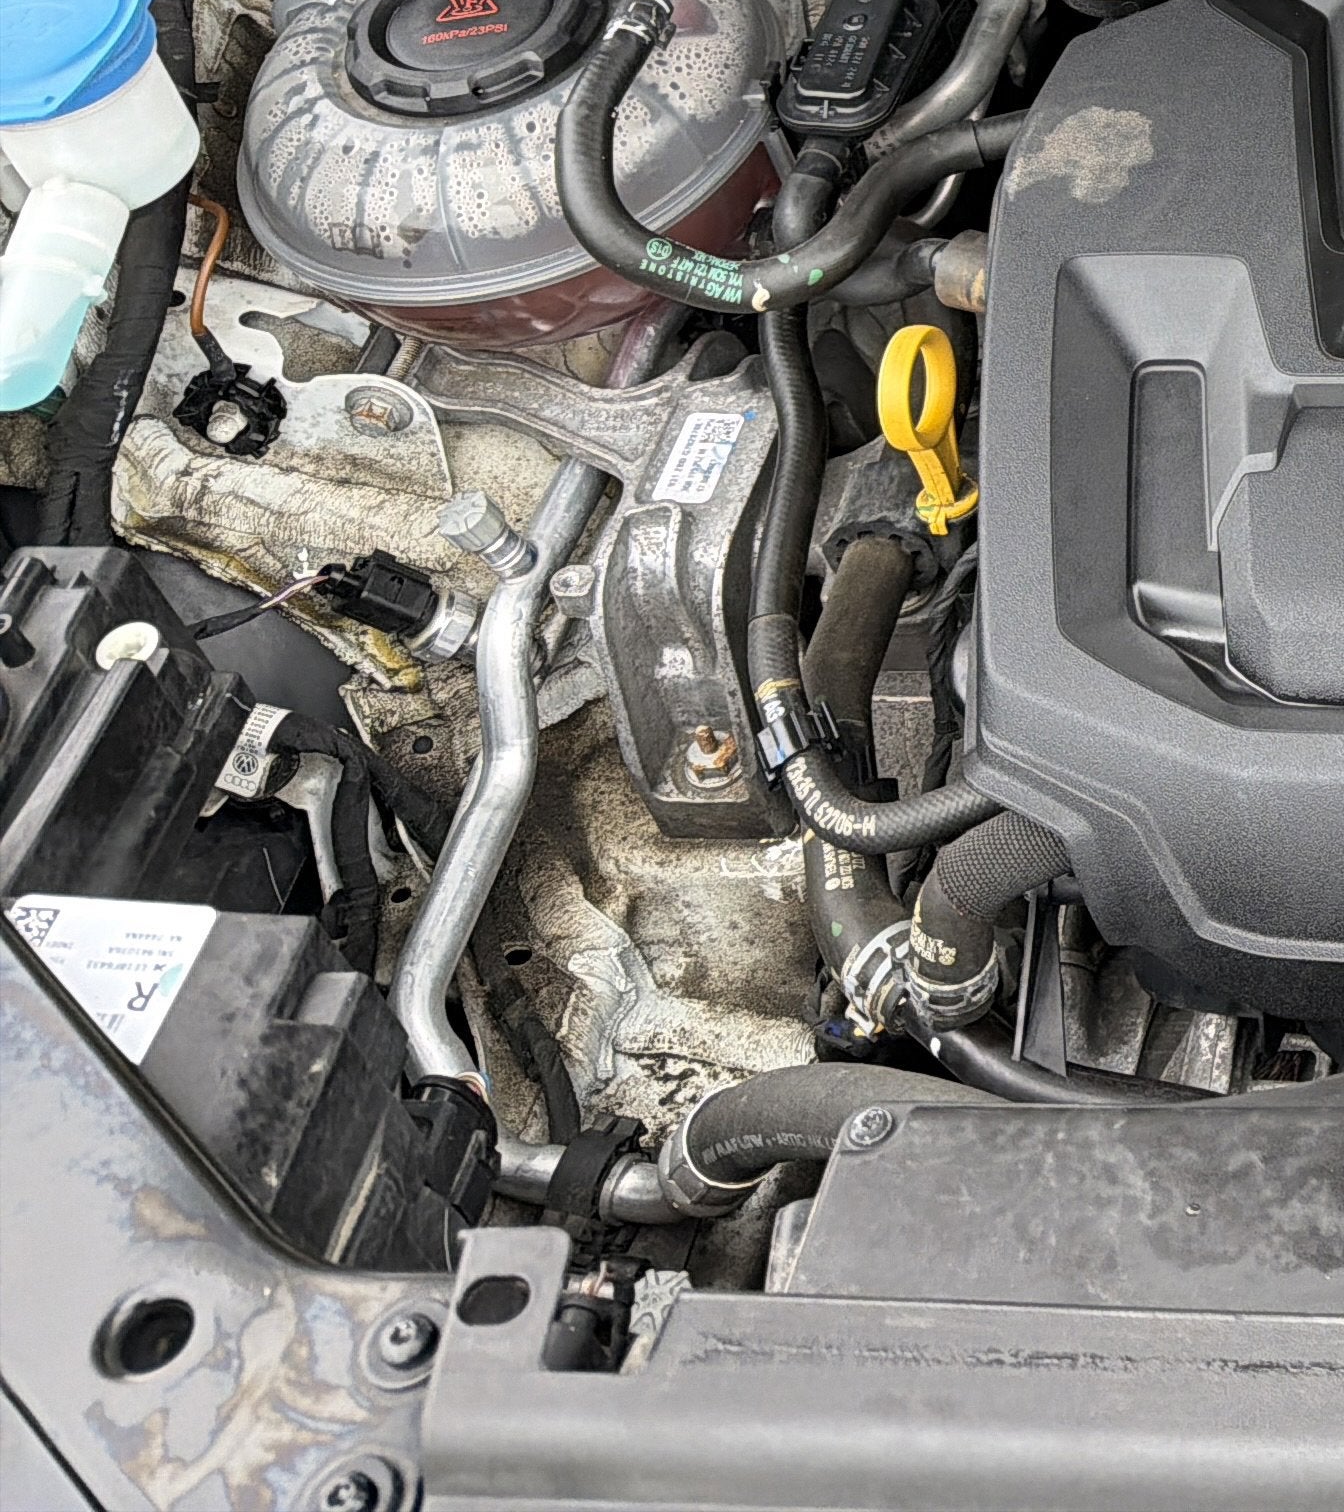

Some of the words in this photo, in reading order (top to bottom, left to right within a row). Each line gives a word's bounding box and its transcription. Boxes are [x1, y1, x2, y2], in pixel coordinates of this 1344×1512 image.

[421, 22, 508, 45] 160kPa/23PSI
[639, 257, 706, 289] TRISTONE
[704, 282, 724, 298] AG
[721, 286, 742, 304] VW
[813, 801, 876, 837] 52706-H
[127, 982, 159, 1012] R
